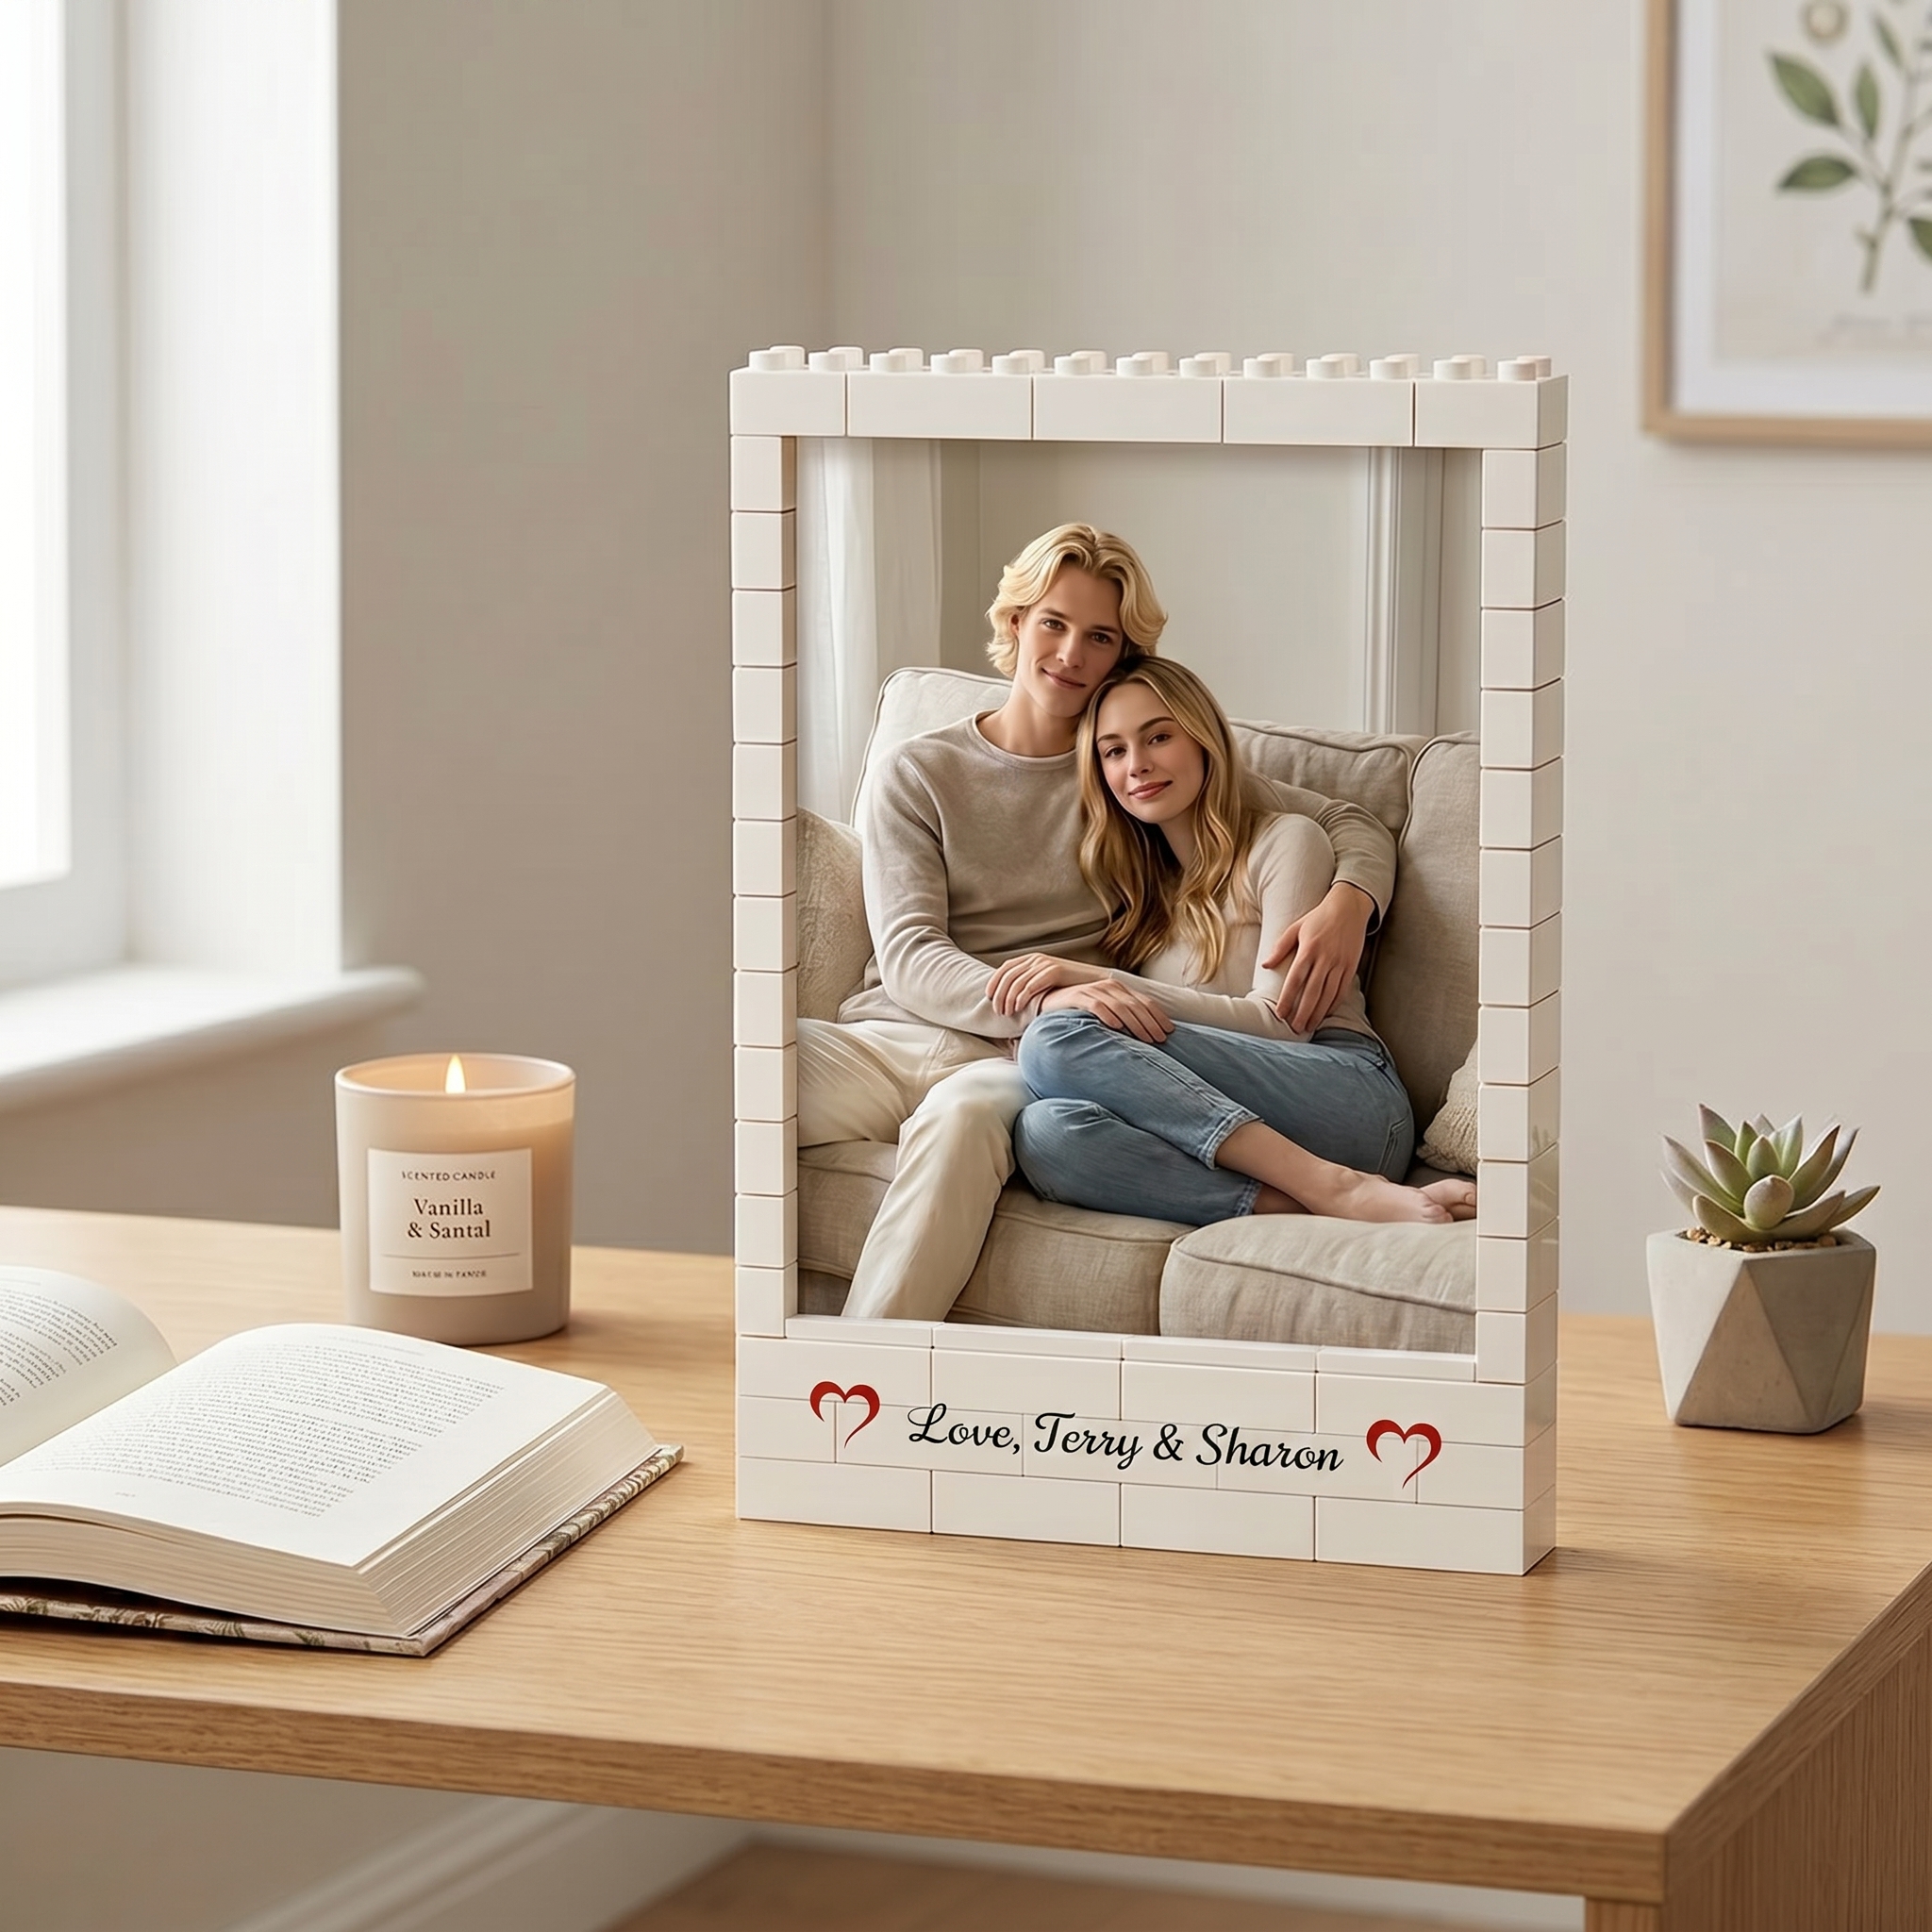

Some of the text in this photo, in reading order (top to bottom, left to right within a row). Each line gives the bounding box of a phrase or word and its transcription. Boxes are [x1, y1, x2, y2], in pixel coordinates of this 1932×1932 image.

[453, 1171, 496, 1181] CANDLE
[413, 1198, 484, 1216] Vanilla
[407, 1220, 491, 1239] & Santal
[907, 1403, 1344, 1472] Love, Terry & Sharon
